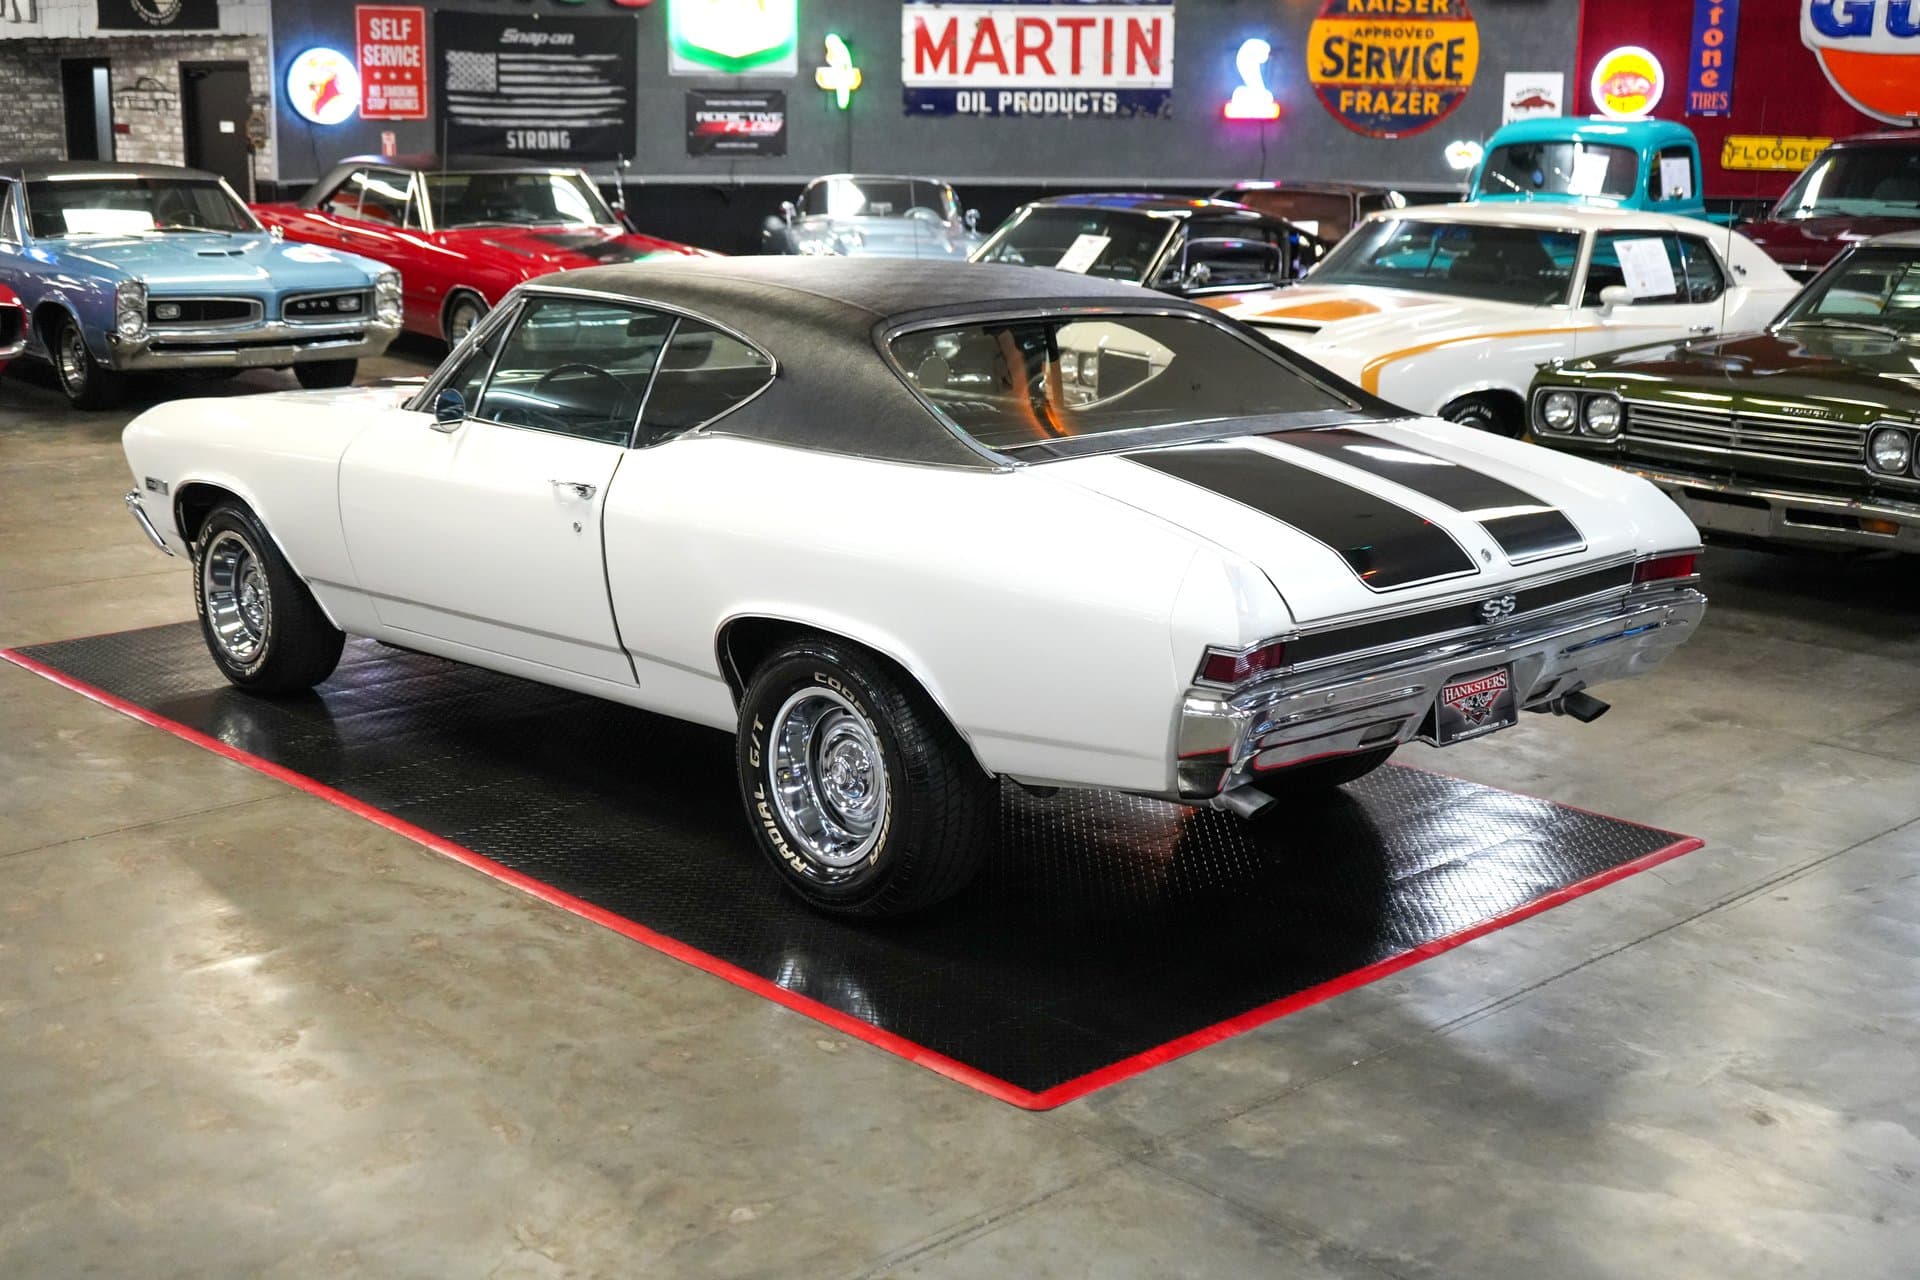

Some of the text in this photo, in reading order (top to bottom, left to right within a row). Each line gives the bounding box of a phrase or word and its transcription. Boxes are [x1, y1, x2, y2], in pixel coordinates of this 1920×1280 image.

[370, 18, 412, 40] SELF
[500, 28, 575, 46] Snap-on
[1354, 27, 1435, 39] APPROVED
[914, 16, 1162, 76] MARTIN
[1700, 0, 1724, 88] tone
[363, 44, 420, 68] SERVICE
[1321, 36, 1465, 80] SERVICE
[957, 91, 1117, 113] OIL PRODUCTS
[1340, 90, 1440, 115] FRAZER
[1691, 92, 1727, 110] TIRES
[506, 130, 571, 149] STRONG
[297, 300, 330, 309] GTO
[1482, 596, 1517, 618] SS
[1445, 673, 1506, 703] HANKSTERS
[750, 713, 765, 768] G/T
[754, 782, 807, 873] RADIAL
